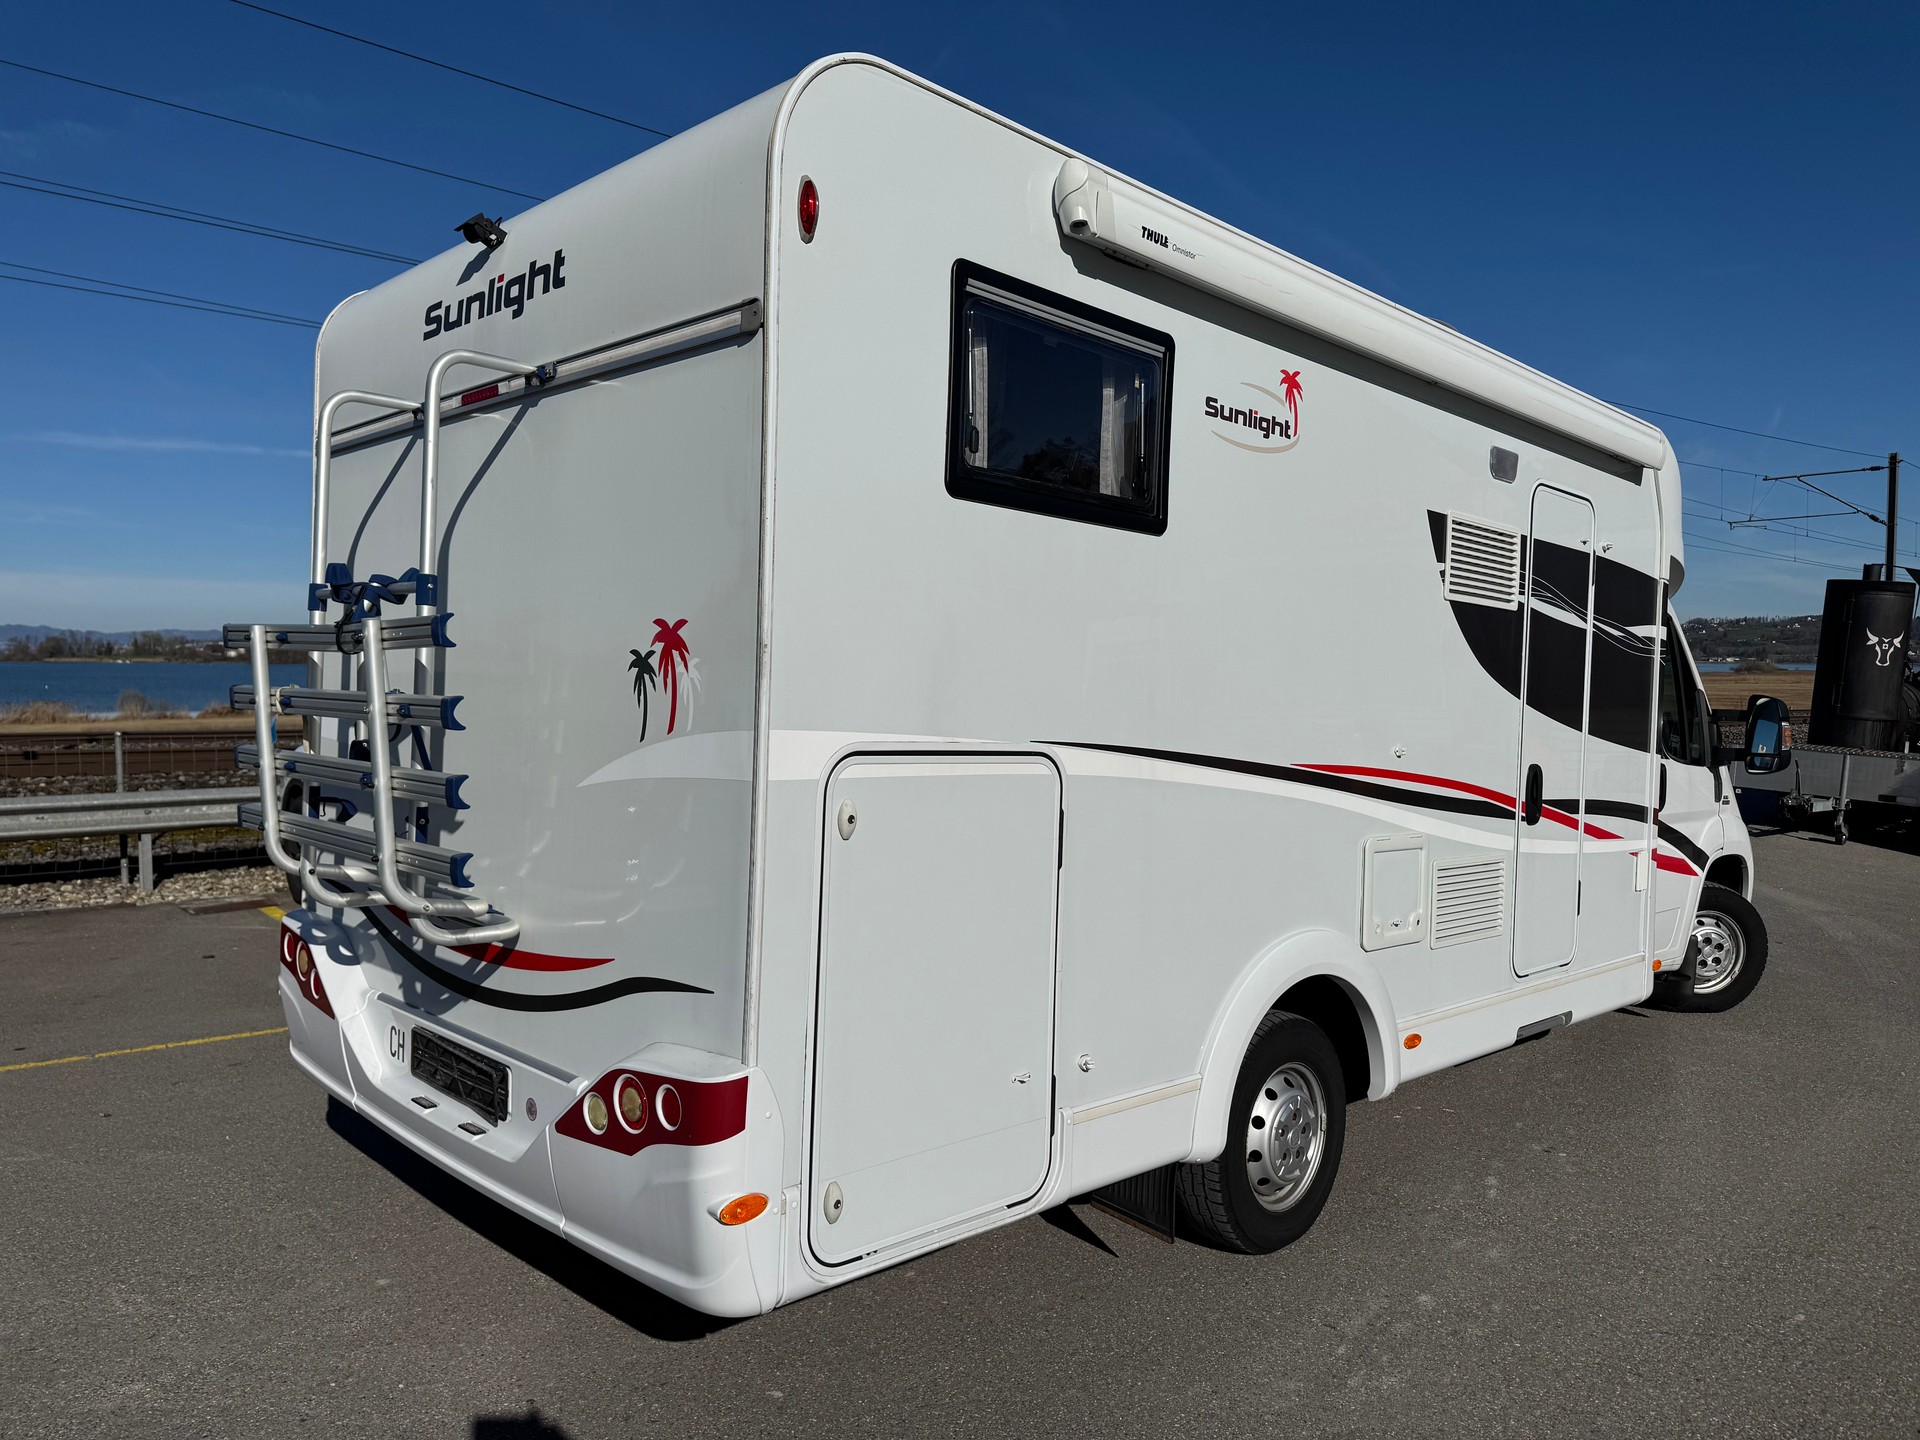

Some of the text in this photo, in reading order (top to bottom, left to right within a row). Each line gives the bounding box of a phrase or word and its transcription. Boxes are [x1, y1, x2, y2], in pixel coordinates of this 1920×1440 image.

[1141, 225, 1197, 260] THULE Omnistor
[423, 248, 566, 342] Sunlight
[1204, 396, 1292, 440] Sunlight
[389, 1025, 405, 1063] CH
